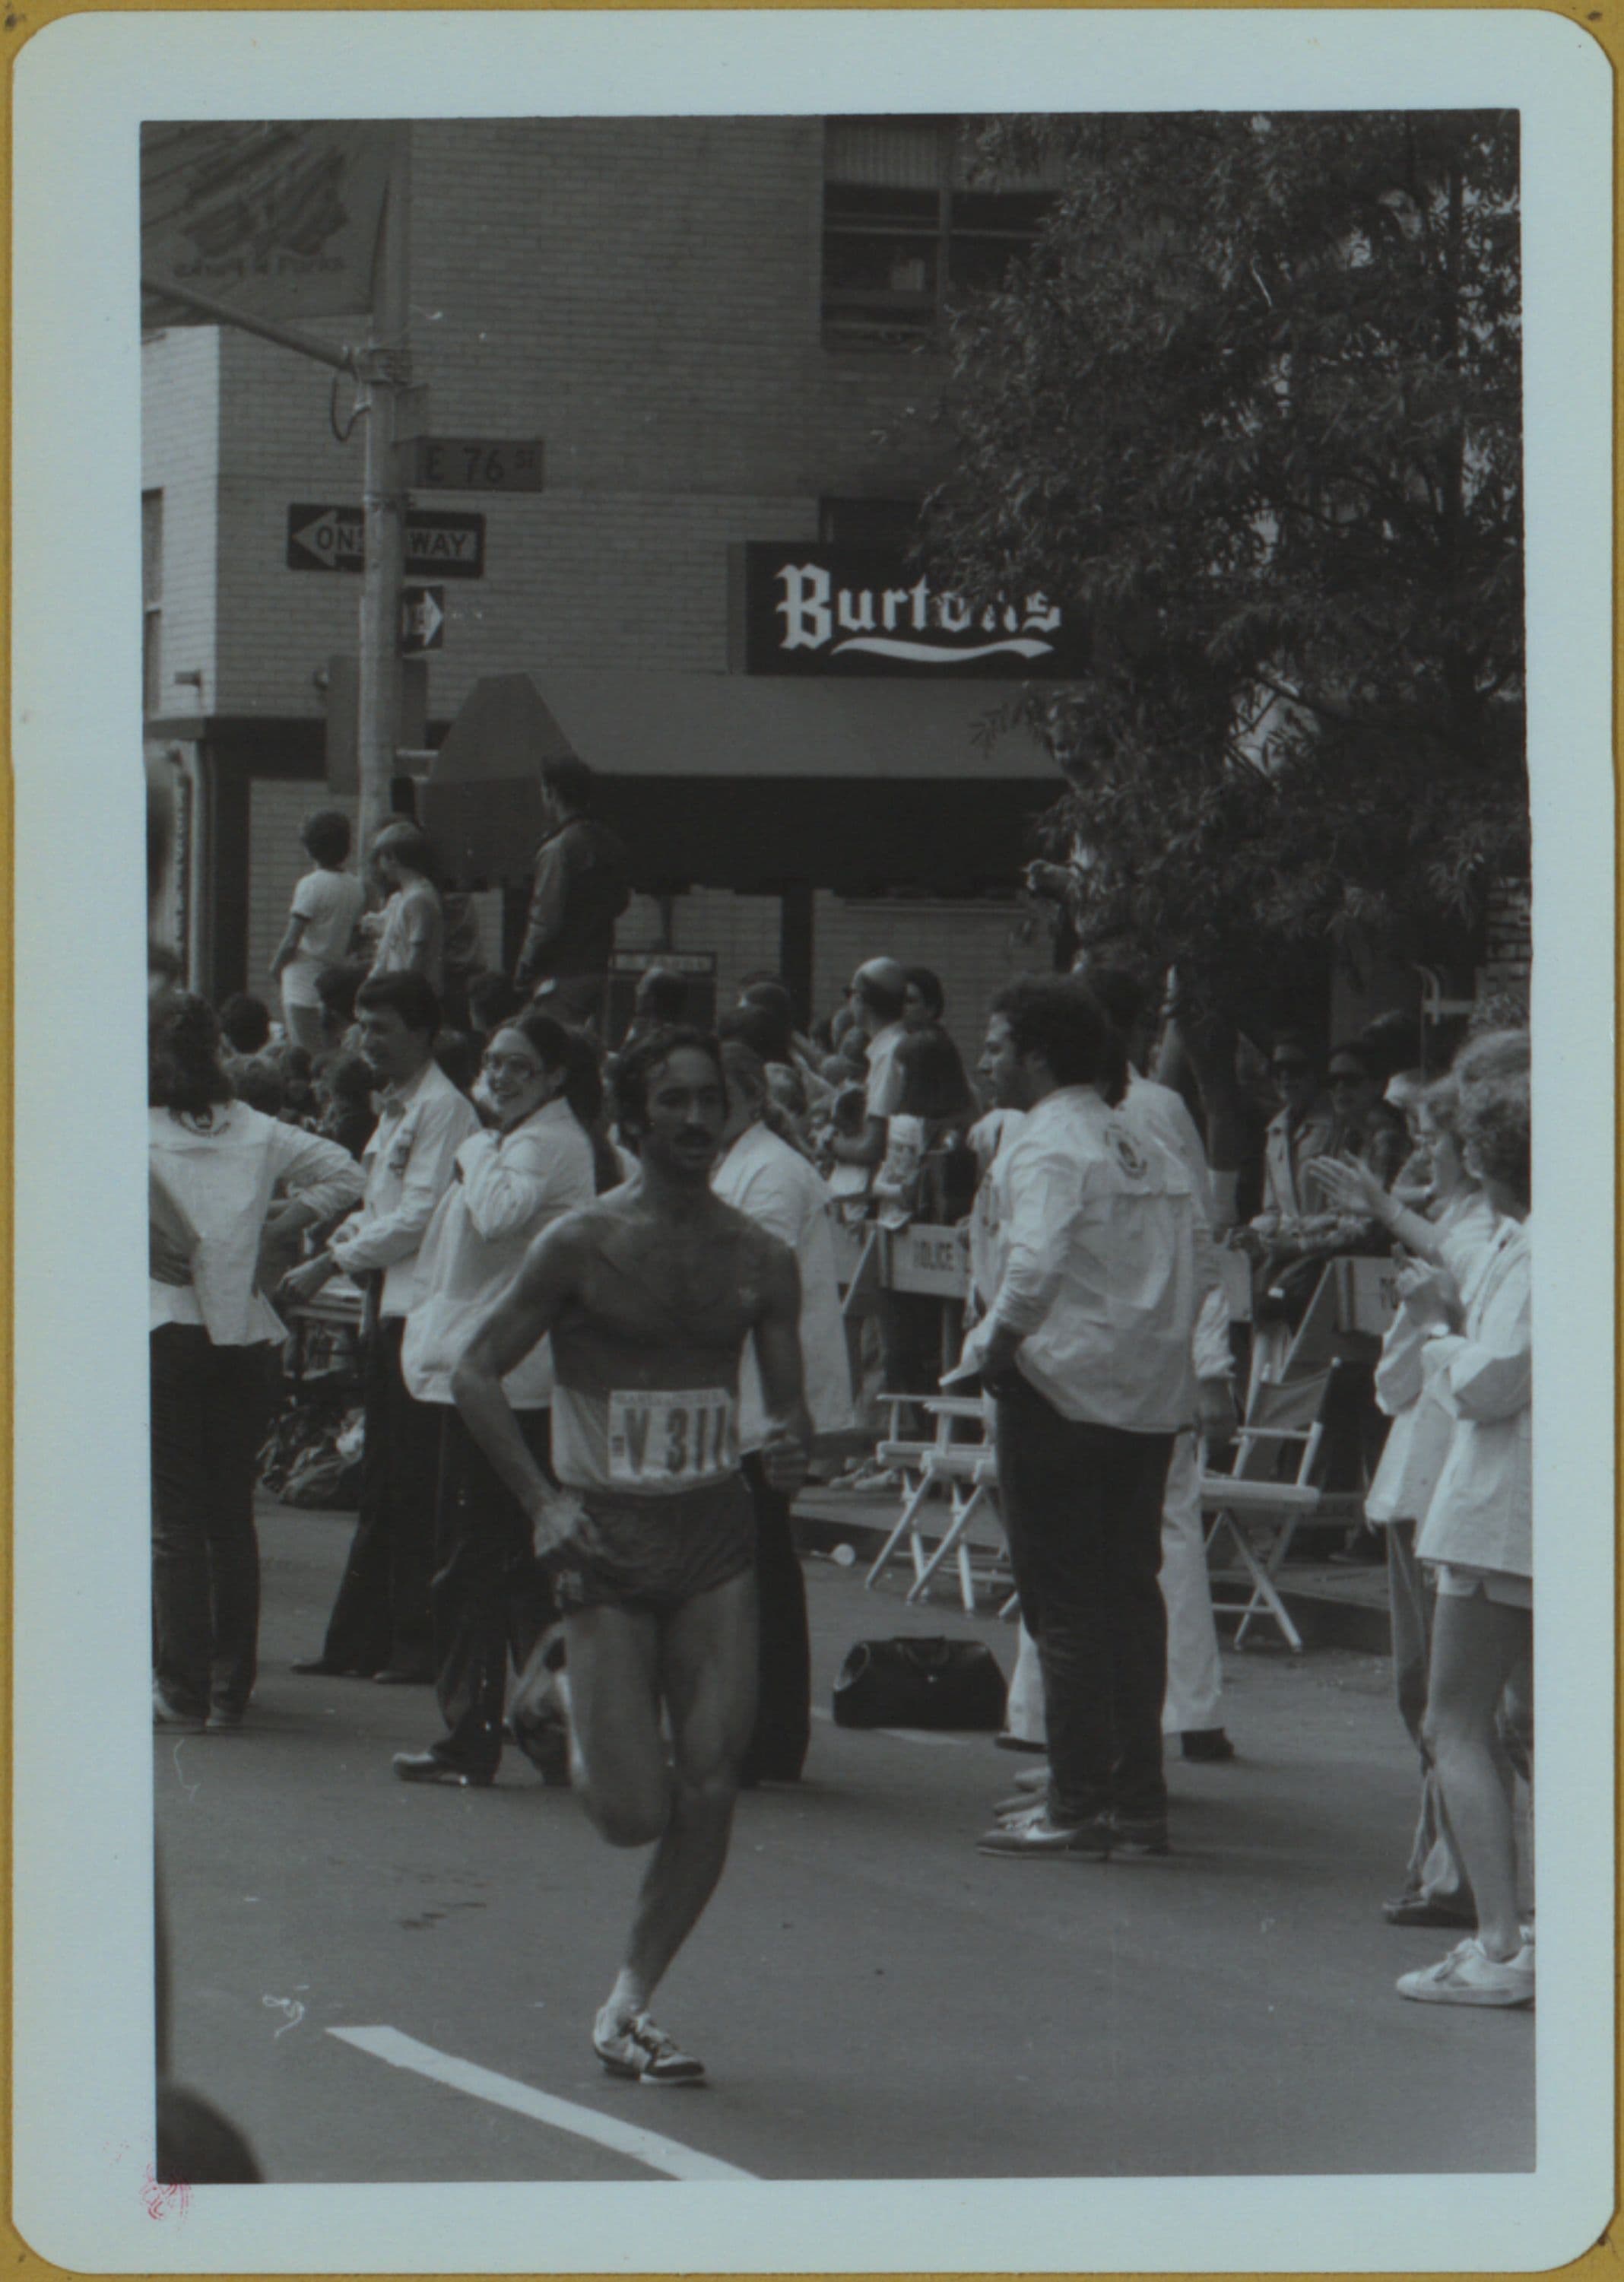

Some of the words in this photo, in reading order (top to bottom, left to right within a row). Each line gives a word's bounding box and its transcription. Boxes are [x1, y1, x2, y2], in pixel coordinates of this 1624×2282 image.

[426, 445, 444, 482] E
[463, 447, 505, 484] 76
[411, 532, 467, 557] WAY
[625, 1408, 651, 1475] V
[666, 1406, 726, 1474] 311
